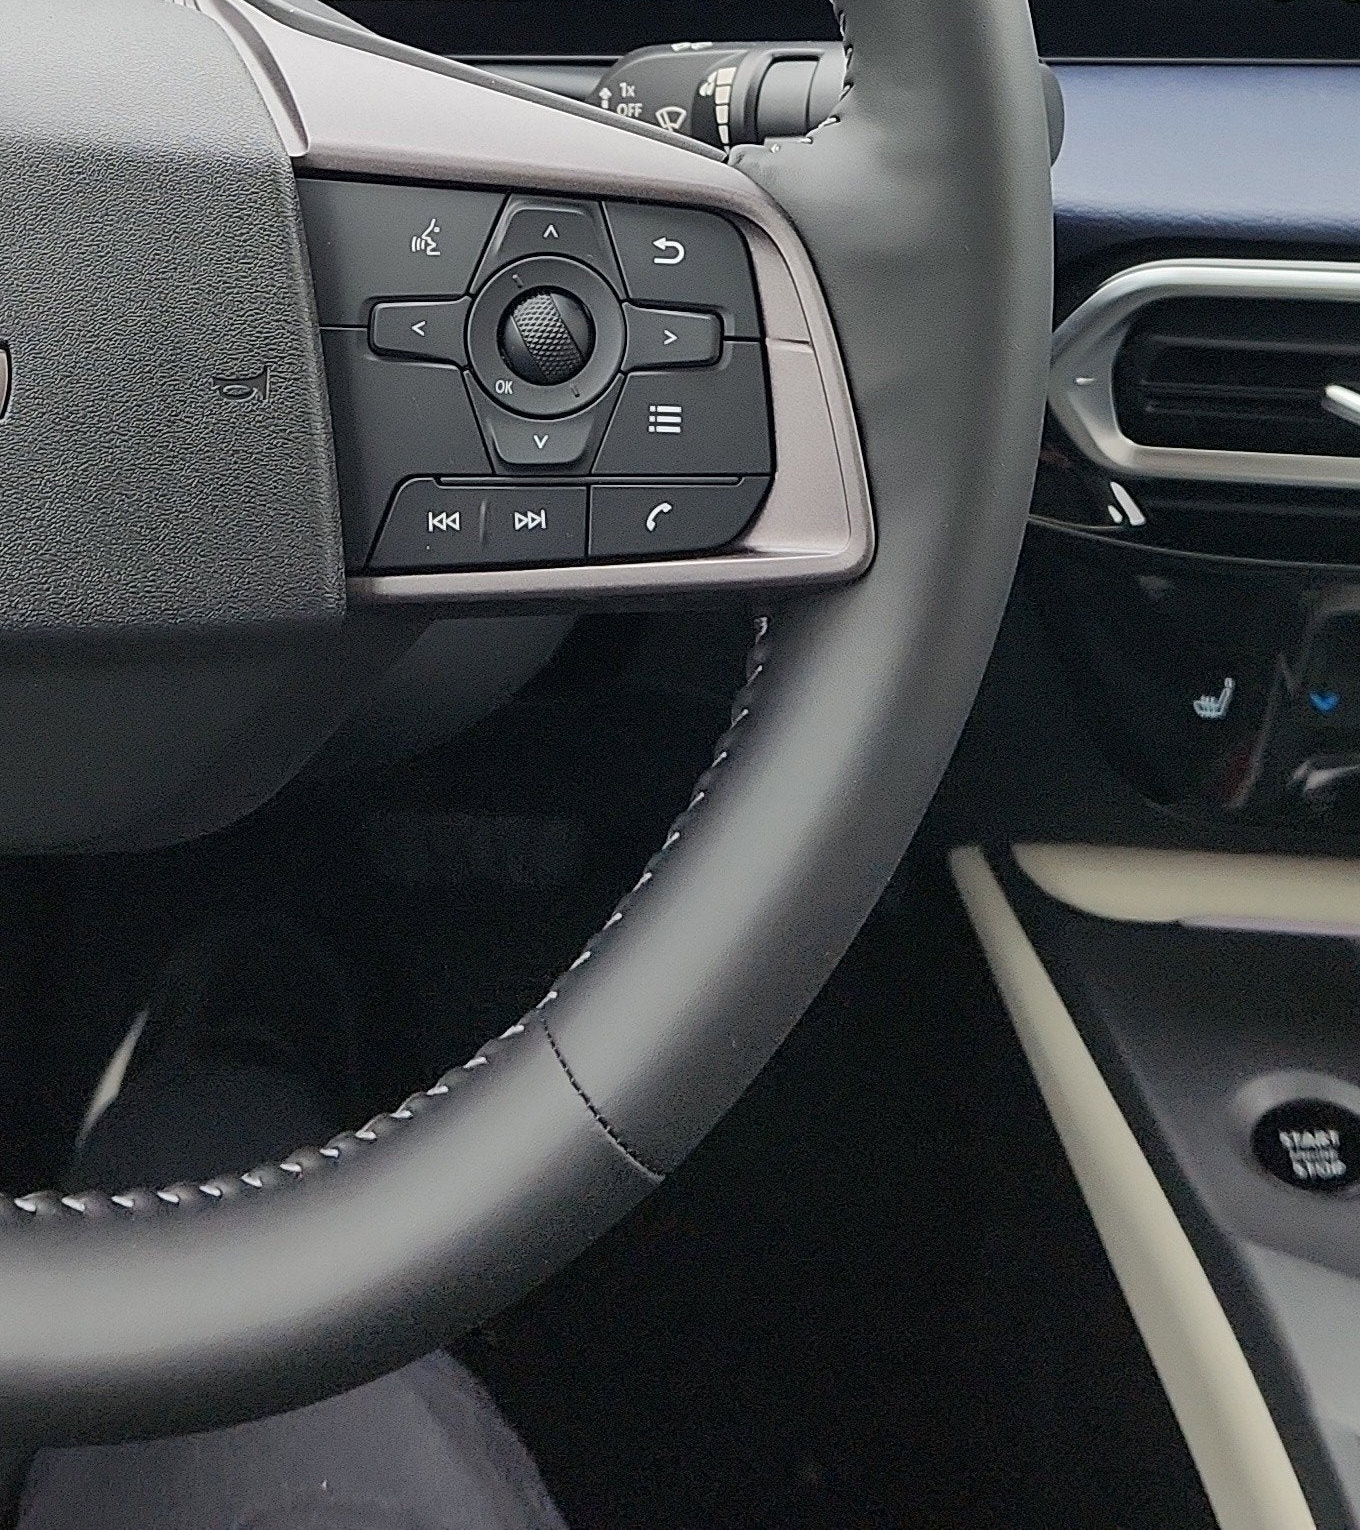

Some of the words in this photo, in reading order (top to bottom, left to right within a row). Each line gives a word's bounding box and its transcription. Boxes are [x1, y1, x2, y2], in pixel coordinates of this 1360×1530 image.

[619, 82, 636, 98] 1x
[616, 103, 643, 118] OFF
[495, 379, 514, 396] OK
[1278, 1129, 1341, 1148] START
[1292, 1161, 1347, 1179] STOP
